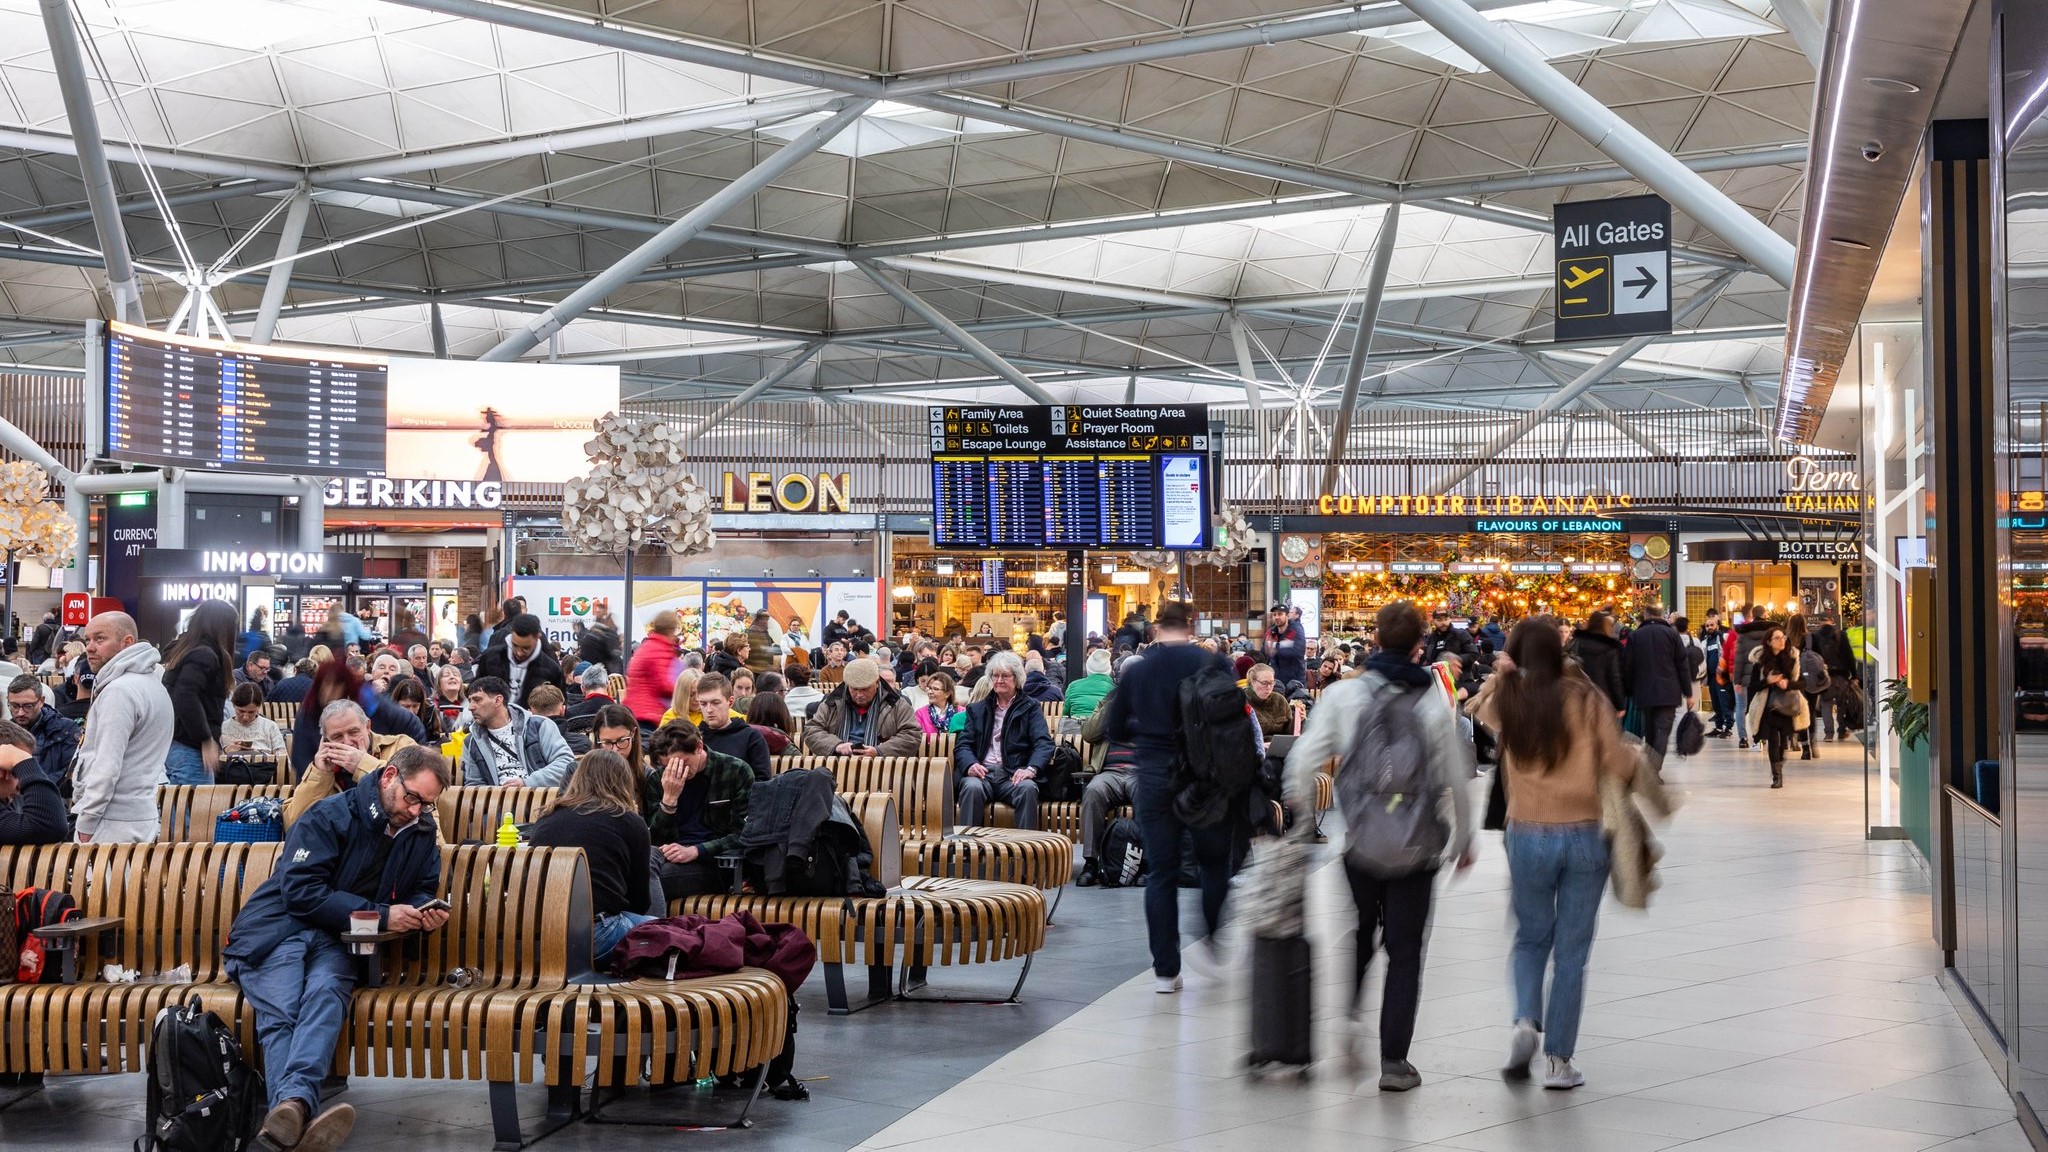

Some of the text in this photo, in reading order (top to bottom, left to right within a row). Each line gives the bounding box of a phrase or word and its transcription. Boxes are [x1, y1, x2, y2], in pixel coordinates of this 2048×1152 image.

[1561, 221, 1664, 248] All Gates
[961, 409, 1024, 421] Family Area
[1082, 408, 1186, 420] Quiet Seating Area
[993, 423, 1029, 433] Toilets
[1083, 423, 1154, 435] Prayer Room
[962, 439, 1046, 451] Escape Lounge
[1065, 438, 1126, 449] Assistance
[404, 481, 502, 509] KING
[723, 471, 851, 512] LEON
[1320, 494, 1631, 516] COMPTOIR LIBANAIS
[1786, 495, 1858, 510] ITALIAN
[1477, 521, 1621, 531] FLAVOURS OF LEBANON
[113, 528, 158, 541] CURRENCY
[1779, 541, 1858, 553] BOTTEGA
[203, 551, 323, 573] INMOTION
[163, 583, 237, 601] INMOTION
[69, 600, 84, 609] ATM
[548, 596, 609, 616] LEON
[1119, 842, 1143, 885] NIKE
